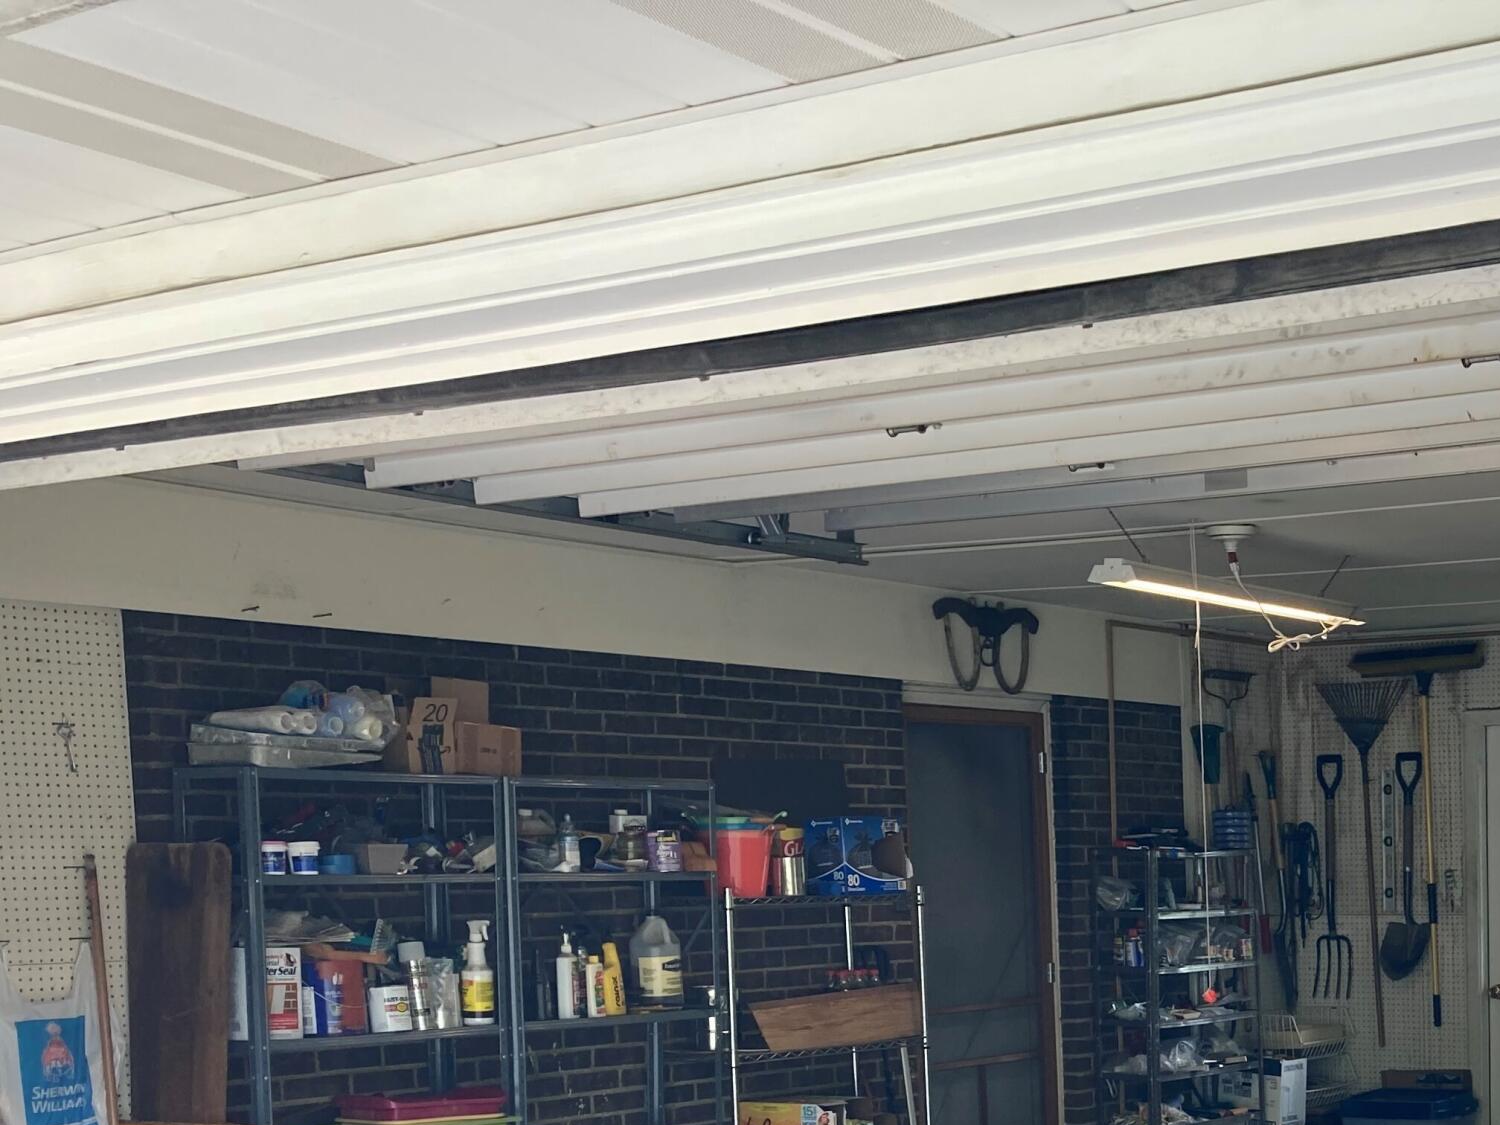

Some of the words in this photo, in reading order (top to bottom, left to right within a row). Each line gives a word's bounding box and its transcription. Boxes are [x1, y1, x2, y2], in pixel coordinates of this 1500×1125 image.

[422, 703, 448, 722] 20
[783, 840, 804, 857] GL
[833, 871, 844, 881] 80
[847, 874, 861, 887] 80
